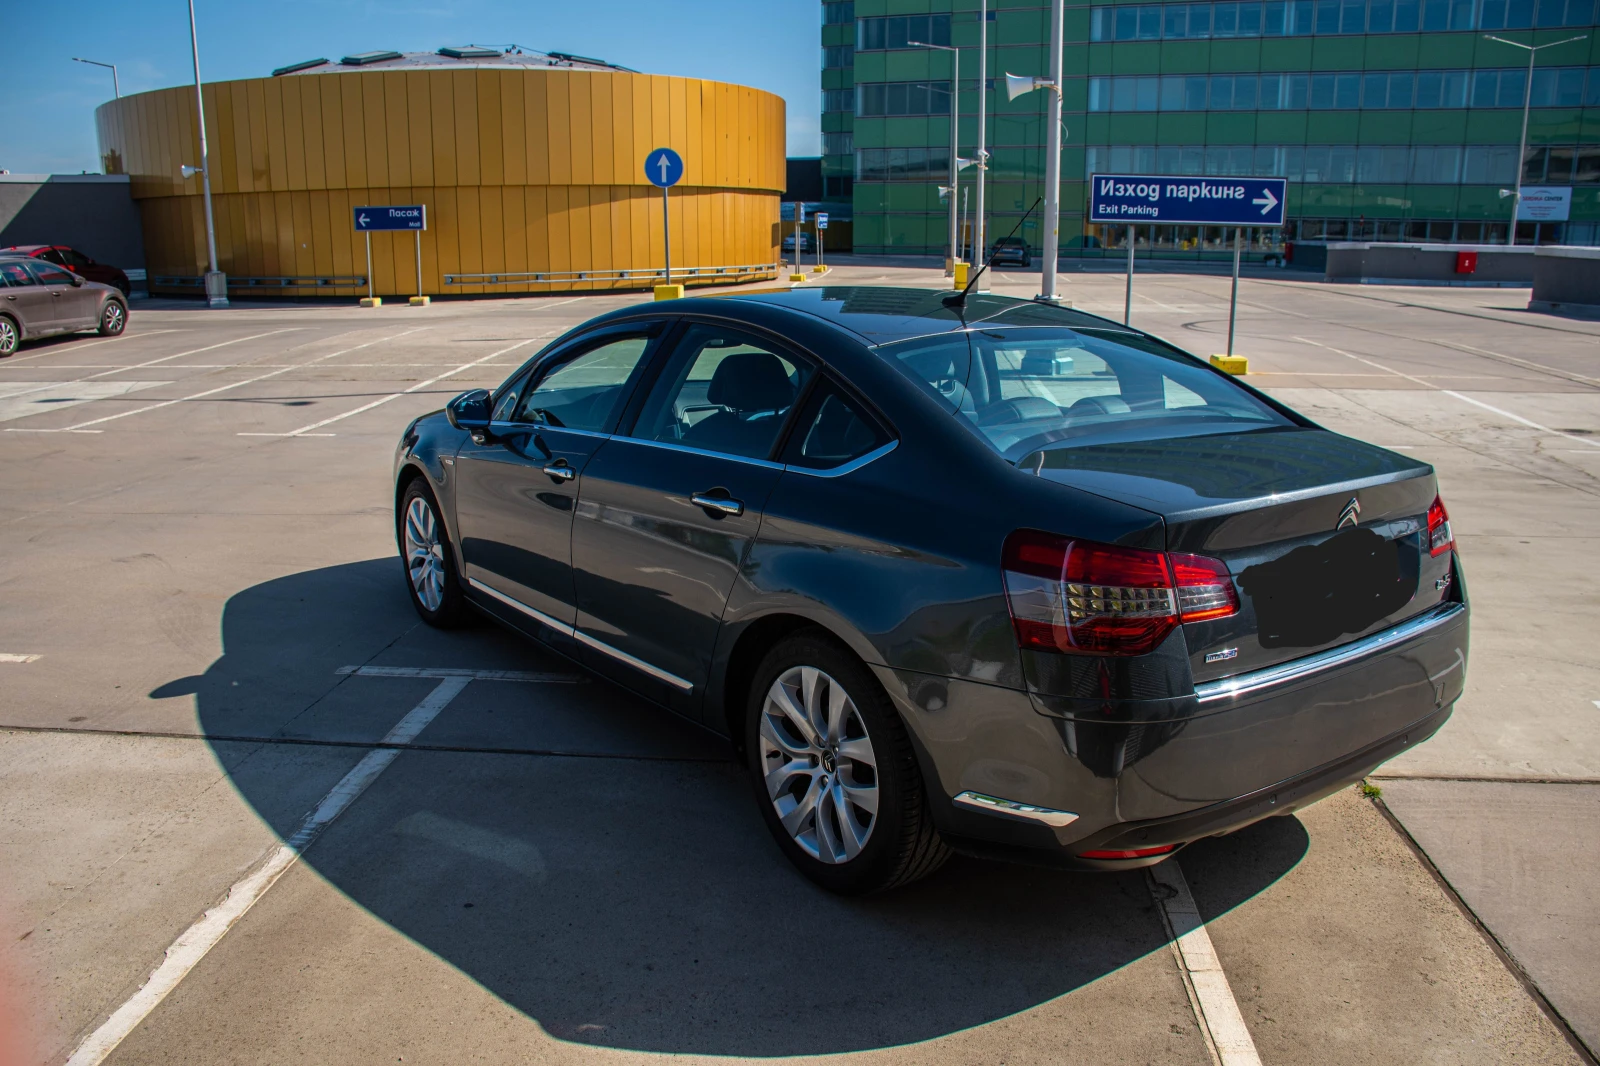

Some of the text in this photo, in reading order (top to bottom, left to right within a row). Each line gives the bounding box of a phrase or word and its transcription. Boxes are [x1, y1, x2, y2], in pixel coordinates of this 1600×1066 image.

[1100, 179, 1245, 202] Изход паркинг
[389, 209, 420, 217] Пасаж
[1099, 204, 1159, 217] Exit Parking
